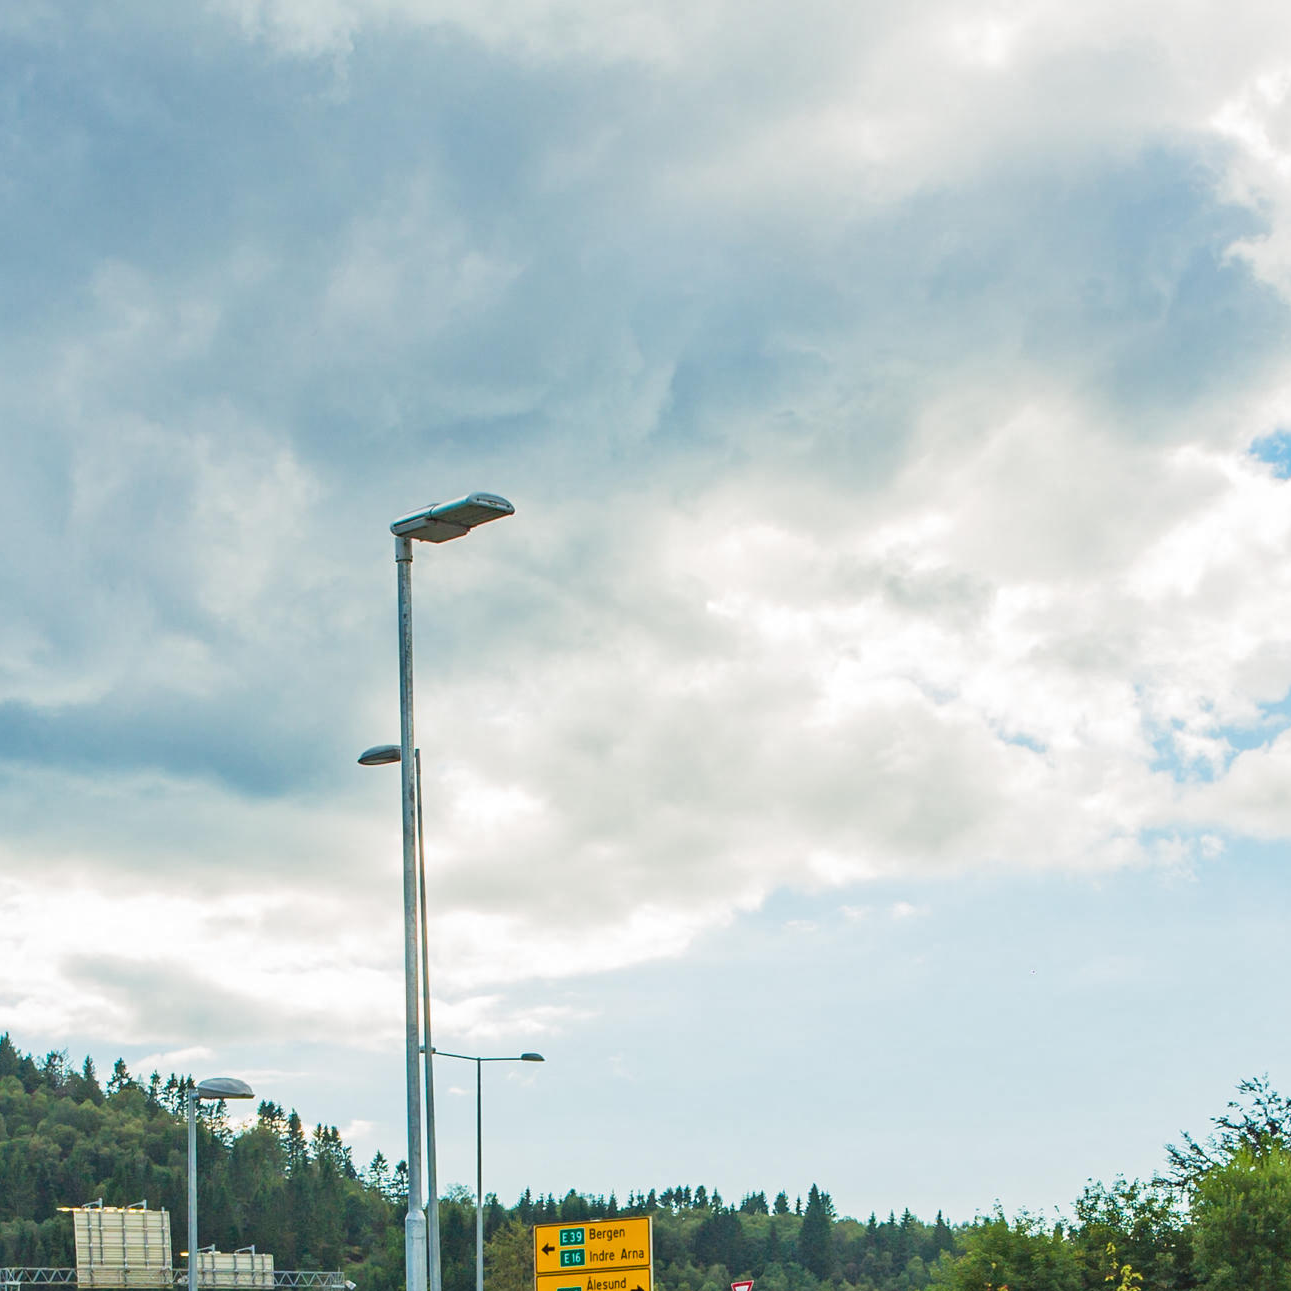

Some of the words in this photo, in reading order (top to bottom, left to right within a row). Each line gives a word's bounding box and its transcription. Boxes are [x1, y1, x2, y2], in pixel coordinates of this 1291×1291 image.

[589, 1228, 625, 1241] Bergen
[590, 1250, 615, 1262] Indre
[621, 1248, 644, 1259] Arna
[587, 1276, 626, 1291] Ålesund
